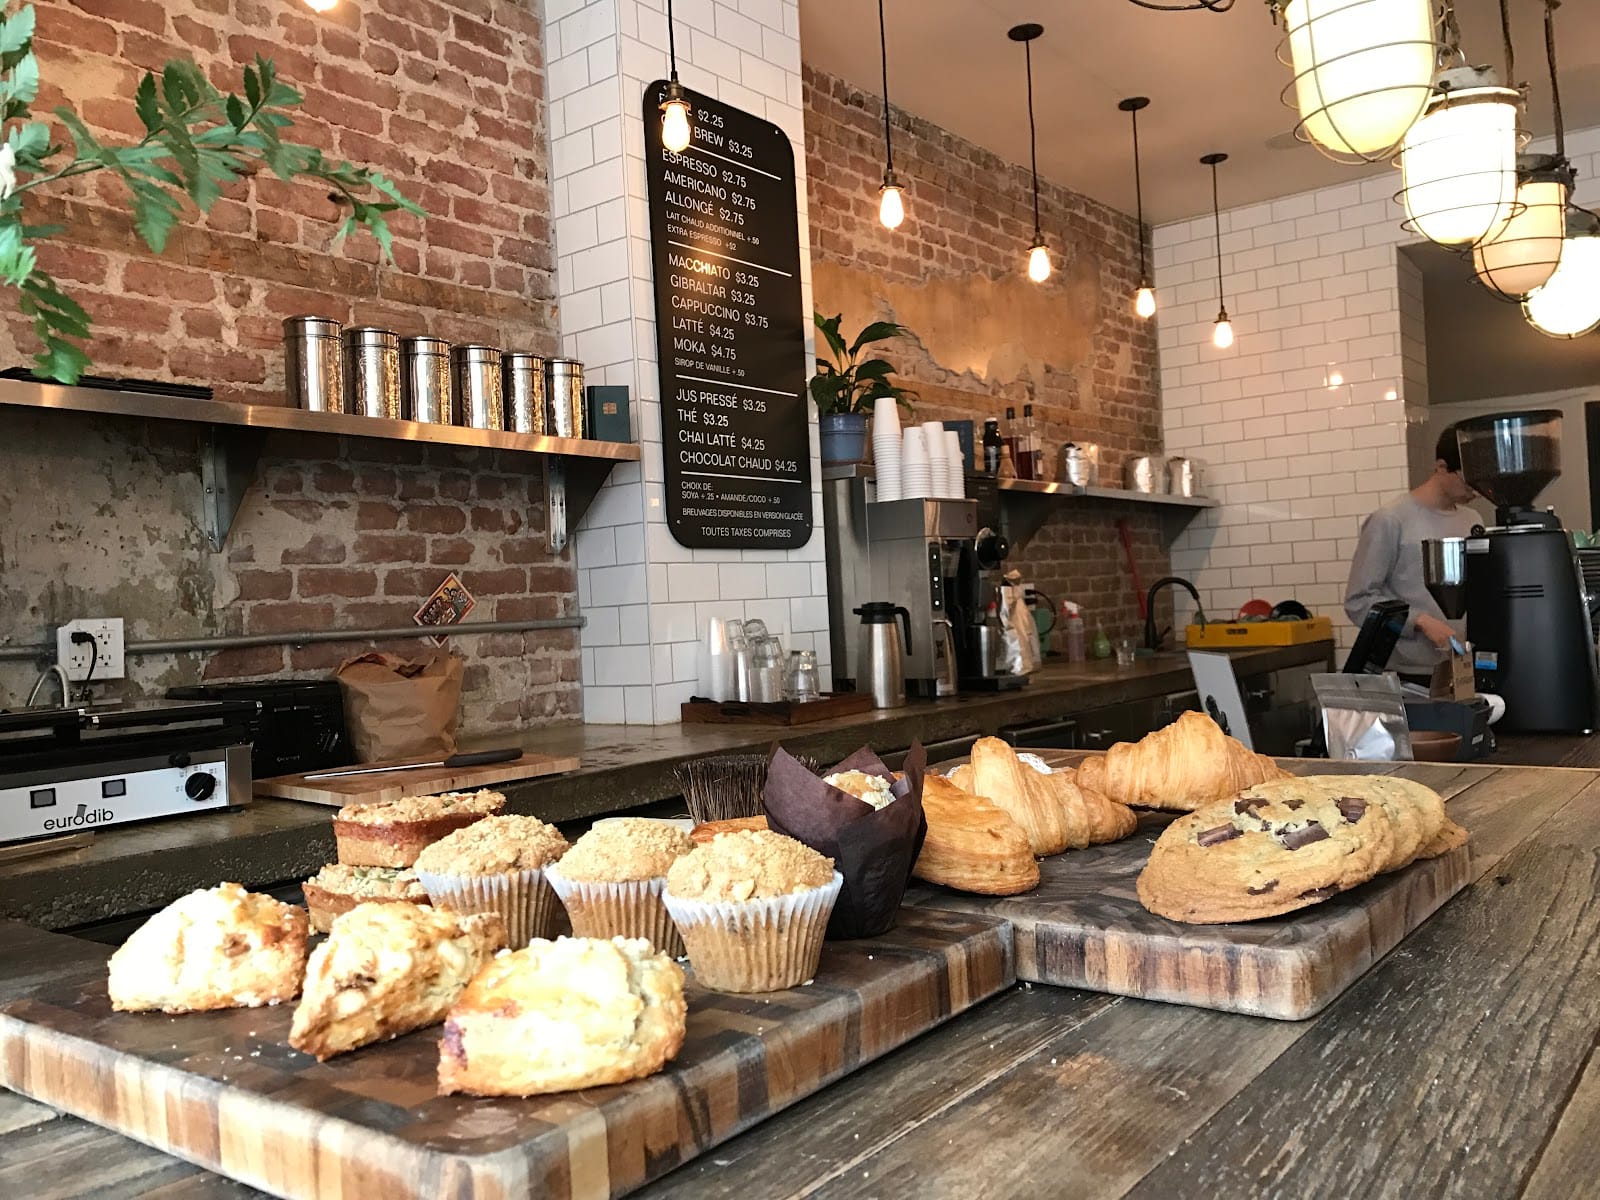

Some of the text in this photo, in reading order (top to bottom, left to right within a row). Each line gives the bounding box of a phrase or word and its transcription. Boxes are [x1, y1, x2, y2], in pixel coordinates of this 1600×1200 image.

[698, 109, 724, 128] $2.25
[694, 126, 753, 159] BREW $3.25
[662, 148, 747, 188] ESPRESSO $2.75
[663, 169, 756, 210] AMERICANO $2.75
[665, 190, 745, 226] ALLONGÉ $2.75
[666, 210, 680, 221] LAIT
[681, 215, 705, 228] CHAUD
[705, 222, 746, 241] ADDITIONNEL
[667, 224, 689, 237] EXTRA
[689, 230, 722, 247] ESPRESSO
[668, 252, 760, 288] MACCHIATO $3.25
[670, 274, 756, 306] GIBRALTAR $3.25
[671, 295, 769, 329] CAPPUCCINO $3.75
[672, 316, 735, 341] LATTÉ $4.25
[673, 337, 737, 360] MOKA $4.75
[674, 357, 695, 368] SIROP
[695, 361, 705, 370] DE
[705, 363, 731, 375] VANILLE
[676, 388, 767, 413] JUS PRESSÉ $3.25
[677, 407, 729, 427] THÉ $3.25
[679, 429, 765, 451] CHAI LATTÉ $4.25
[680, 450, 798, 473] CHOCOLAT CHAUD $4.25
[681, 480, 702, 490] CHOIX
[681, 490, 700, 500] SOYA
[720, 493, 767, 504] AMANDE/COCO
[682, 507, 804, 521] BREUVAGES DISPONIBLES EN VERSION GLACÉE
[701, 526, 792, 538] TOUTES TAXES COMPRISES
[43, 807, 114, 831] eurodib
